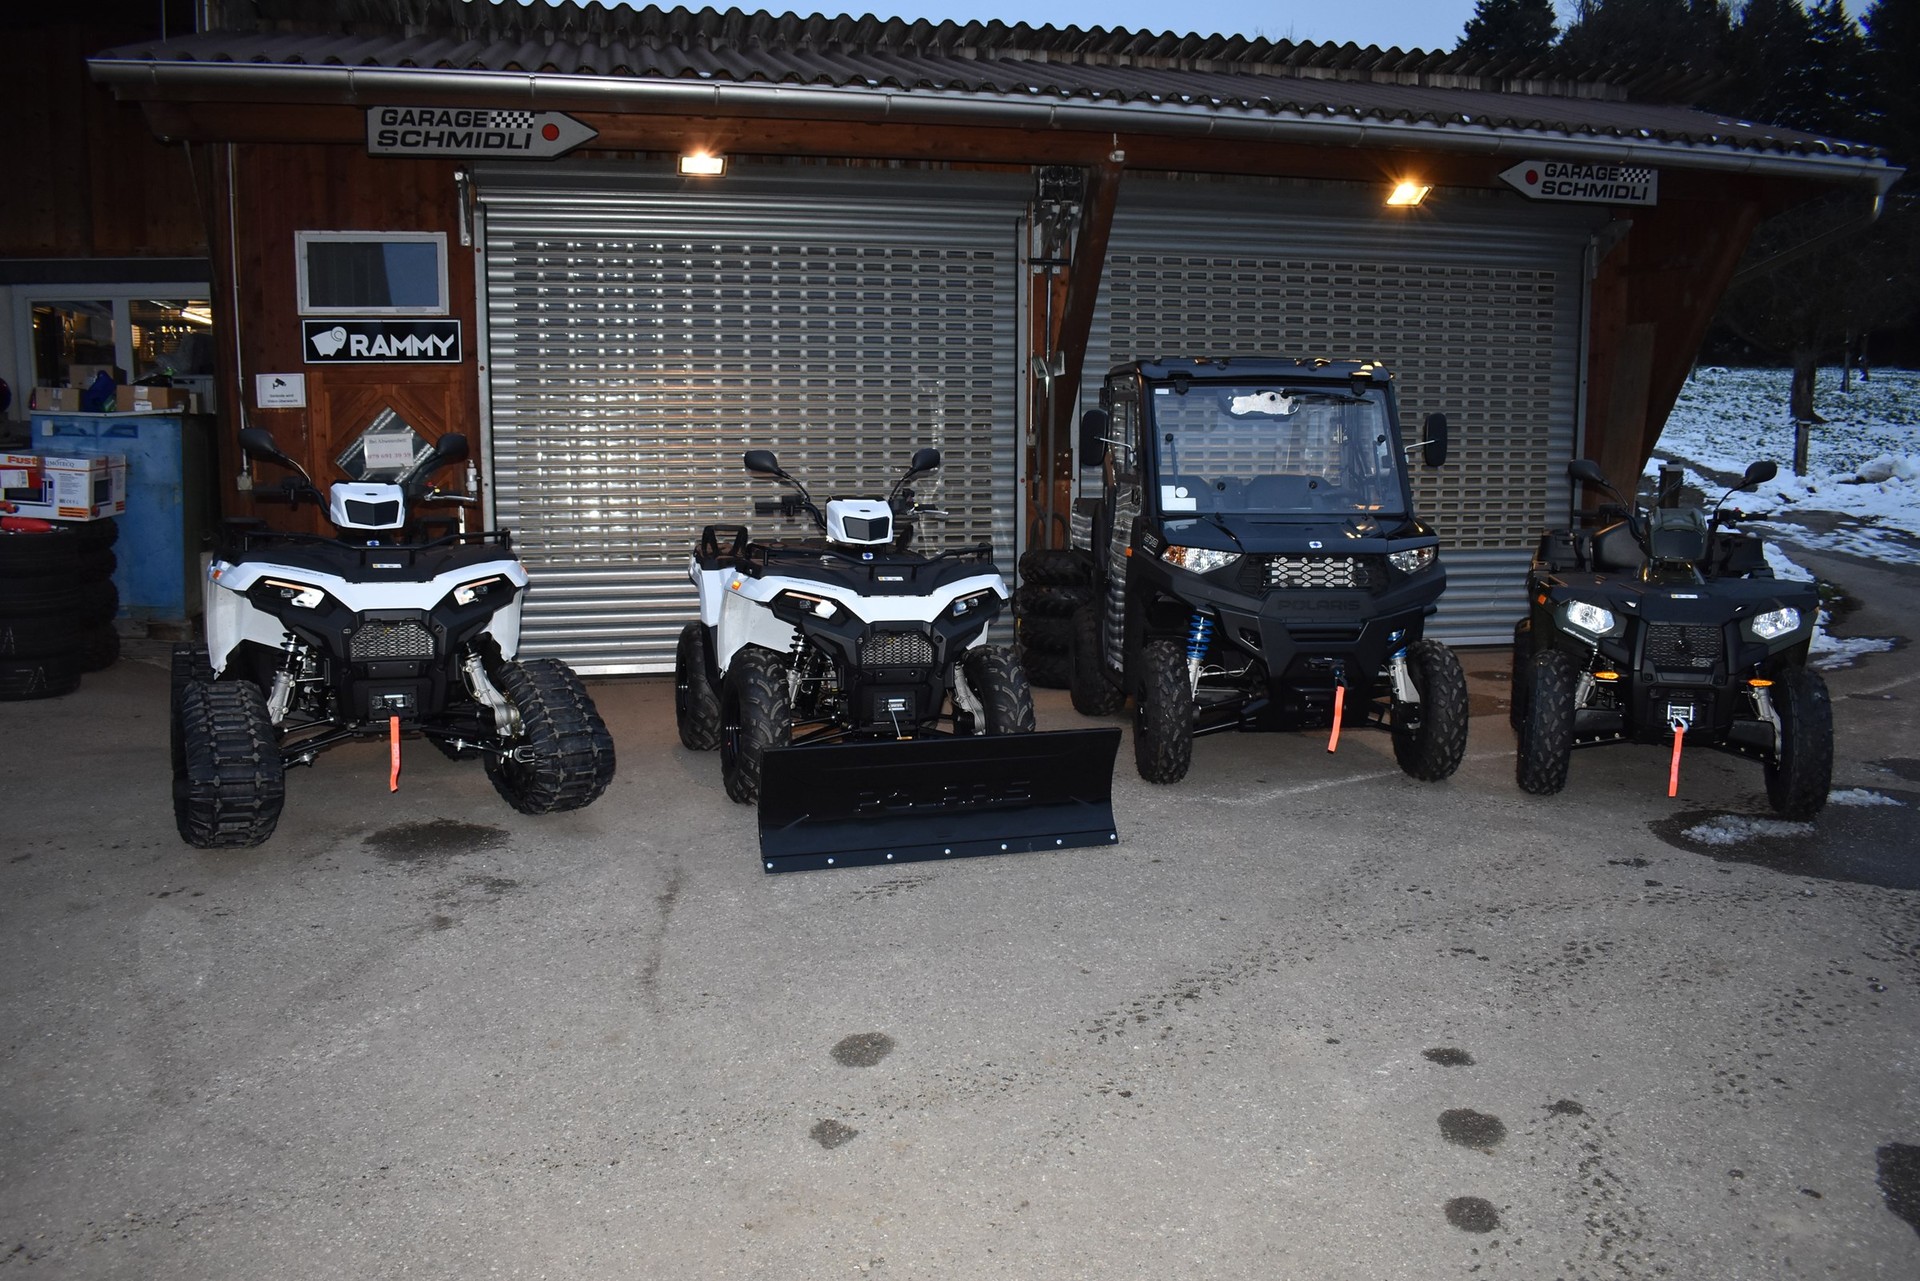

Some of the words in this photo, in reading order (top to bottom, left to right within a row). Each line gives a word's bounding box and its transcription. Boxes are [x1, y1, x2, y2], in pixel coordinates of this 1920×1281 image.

[381, 109, 489, 128] GARAGE
[377, 130, 532, 149] SCHMIDLI
[1544, 163, 1620, 181] GARAGE
[1541, 181, 1648, 200] SCHMIDLI
[350, 334, 455, 357] RAMMY
[1278, 600, 1360, 611] POLARIS
[853, 780, 1032, 812] POLARIS
